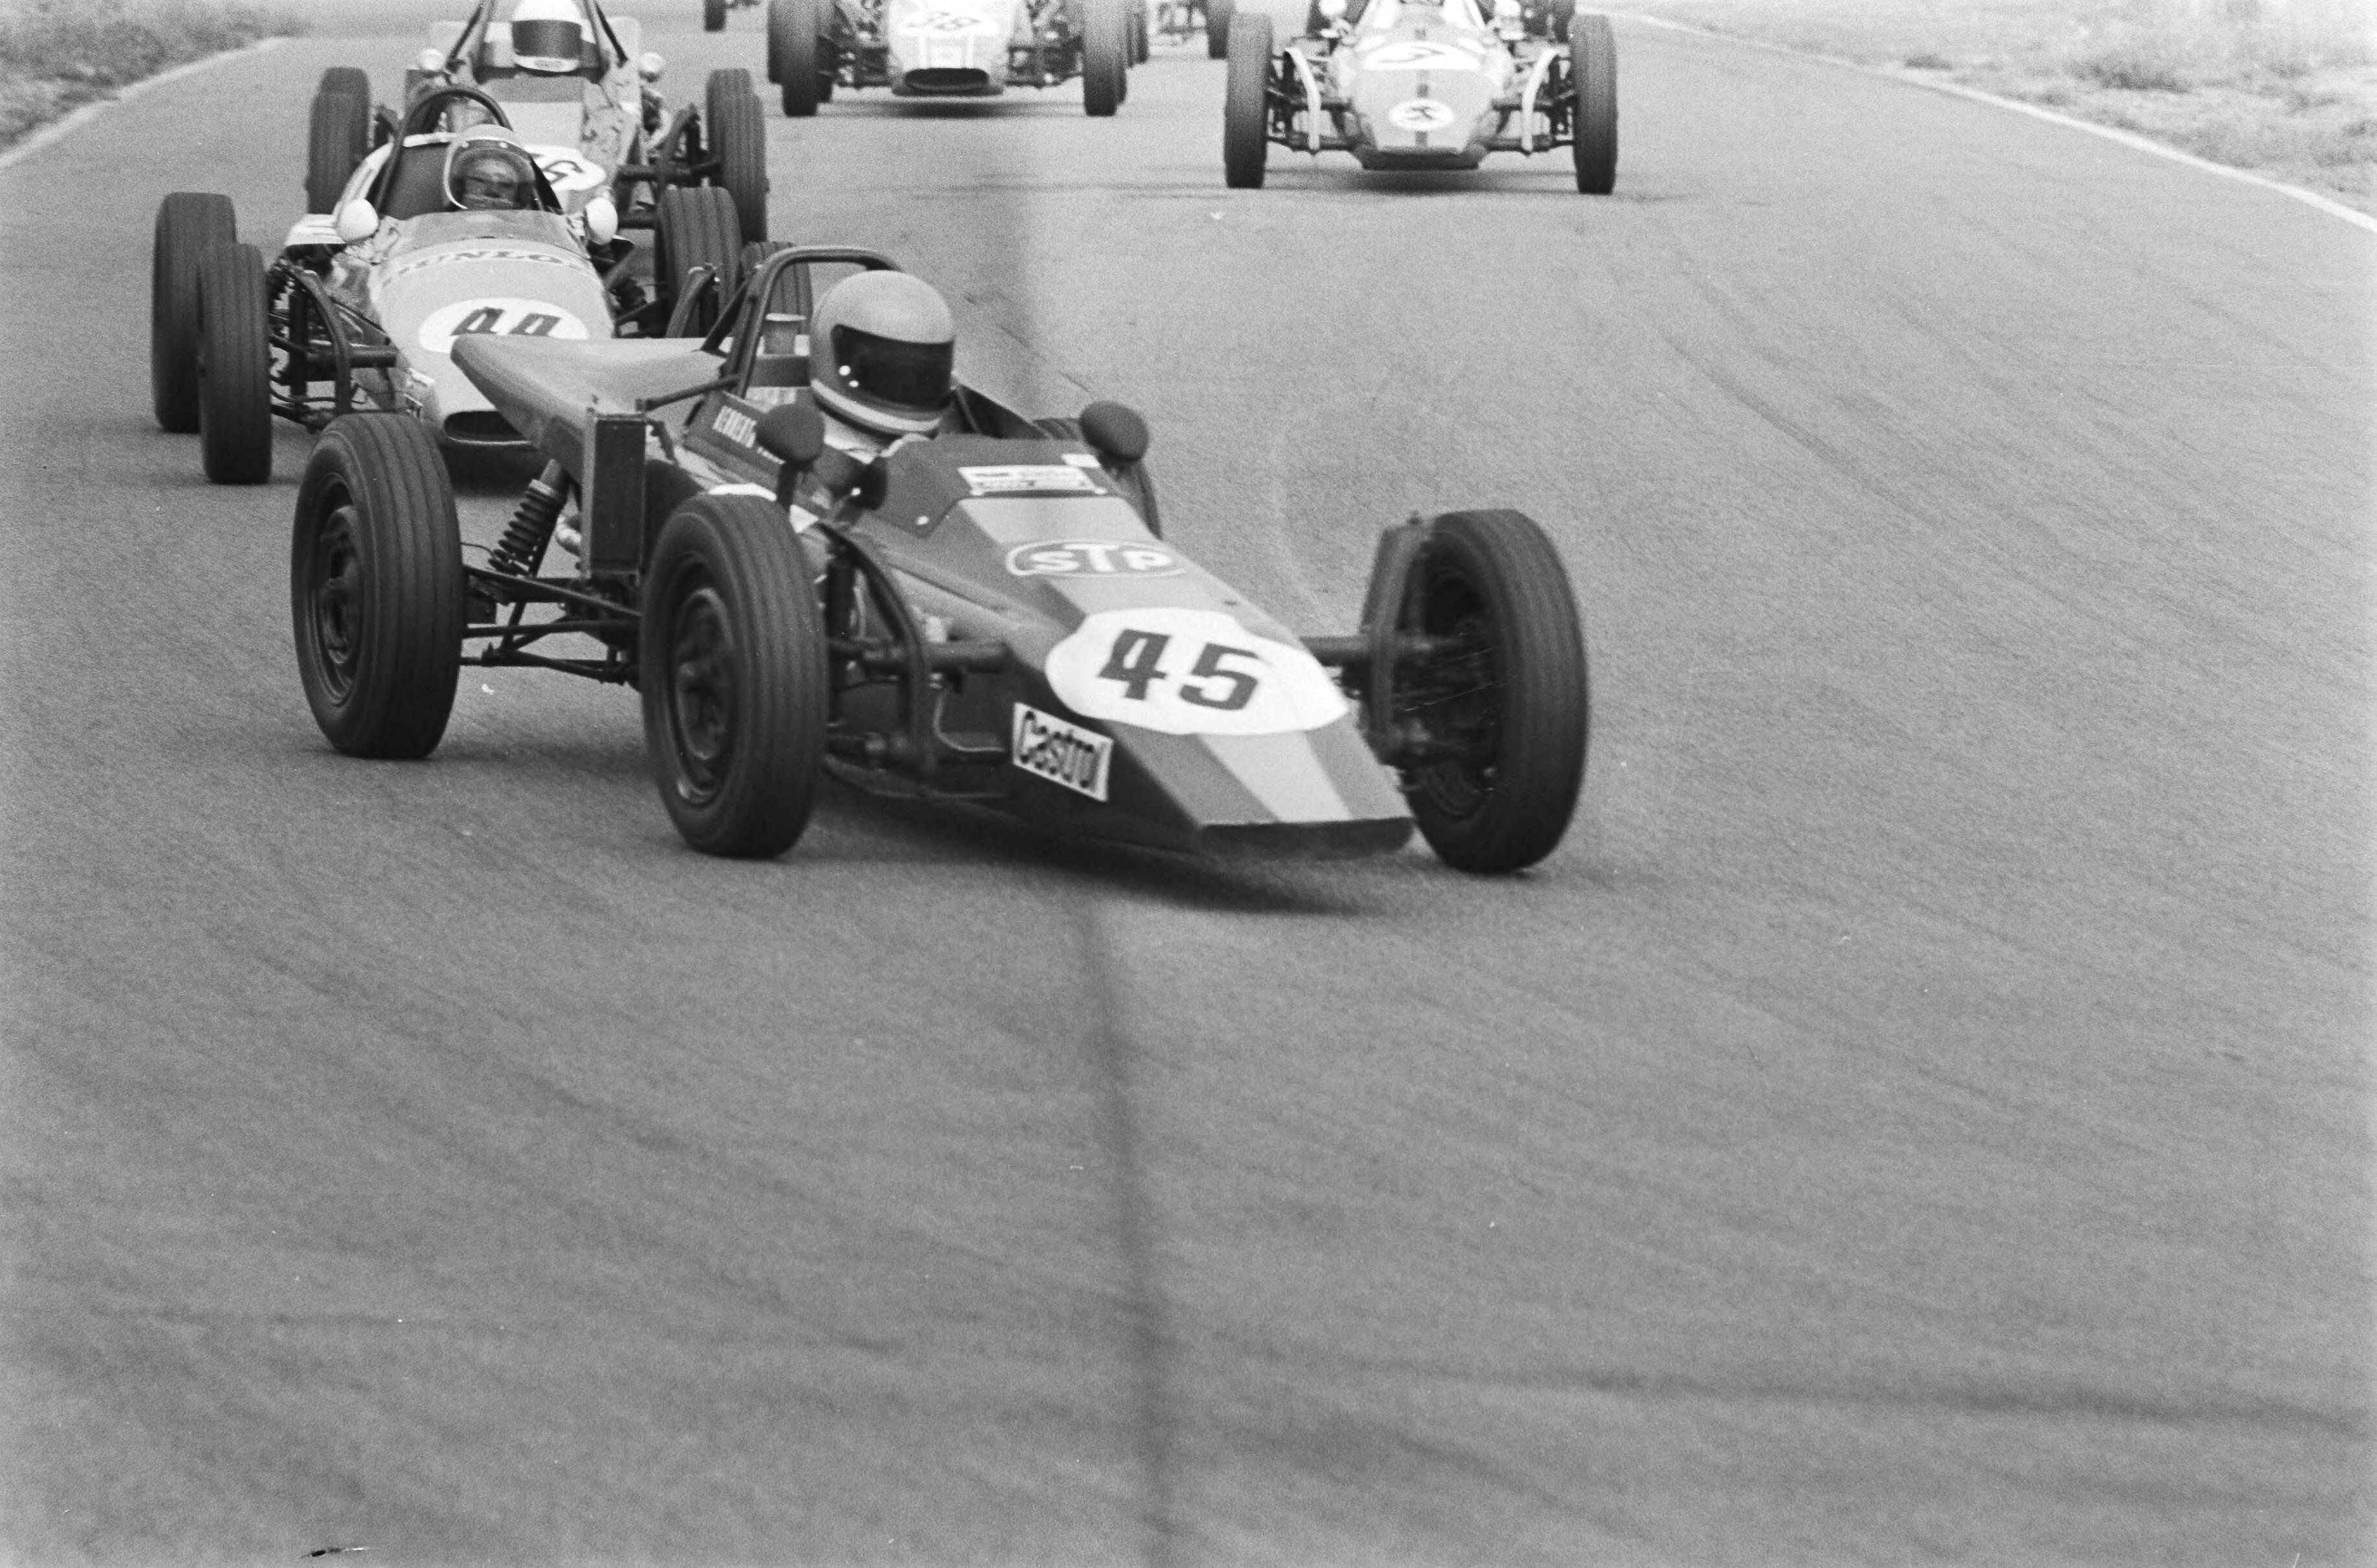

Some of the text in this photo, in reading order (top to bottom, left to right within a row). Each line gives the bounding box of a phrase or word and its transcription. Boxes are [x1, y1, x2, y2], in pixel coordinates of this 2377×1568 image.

[1030, 543, 1172, 573] STP
[1098, 628, 1265, 711] 45
[1019, 711, 1106, 792] Castrol
